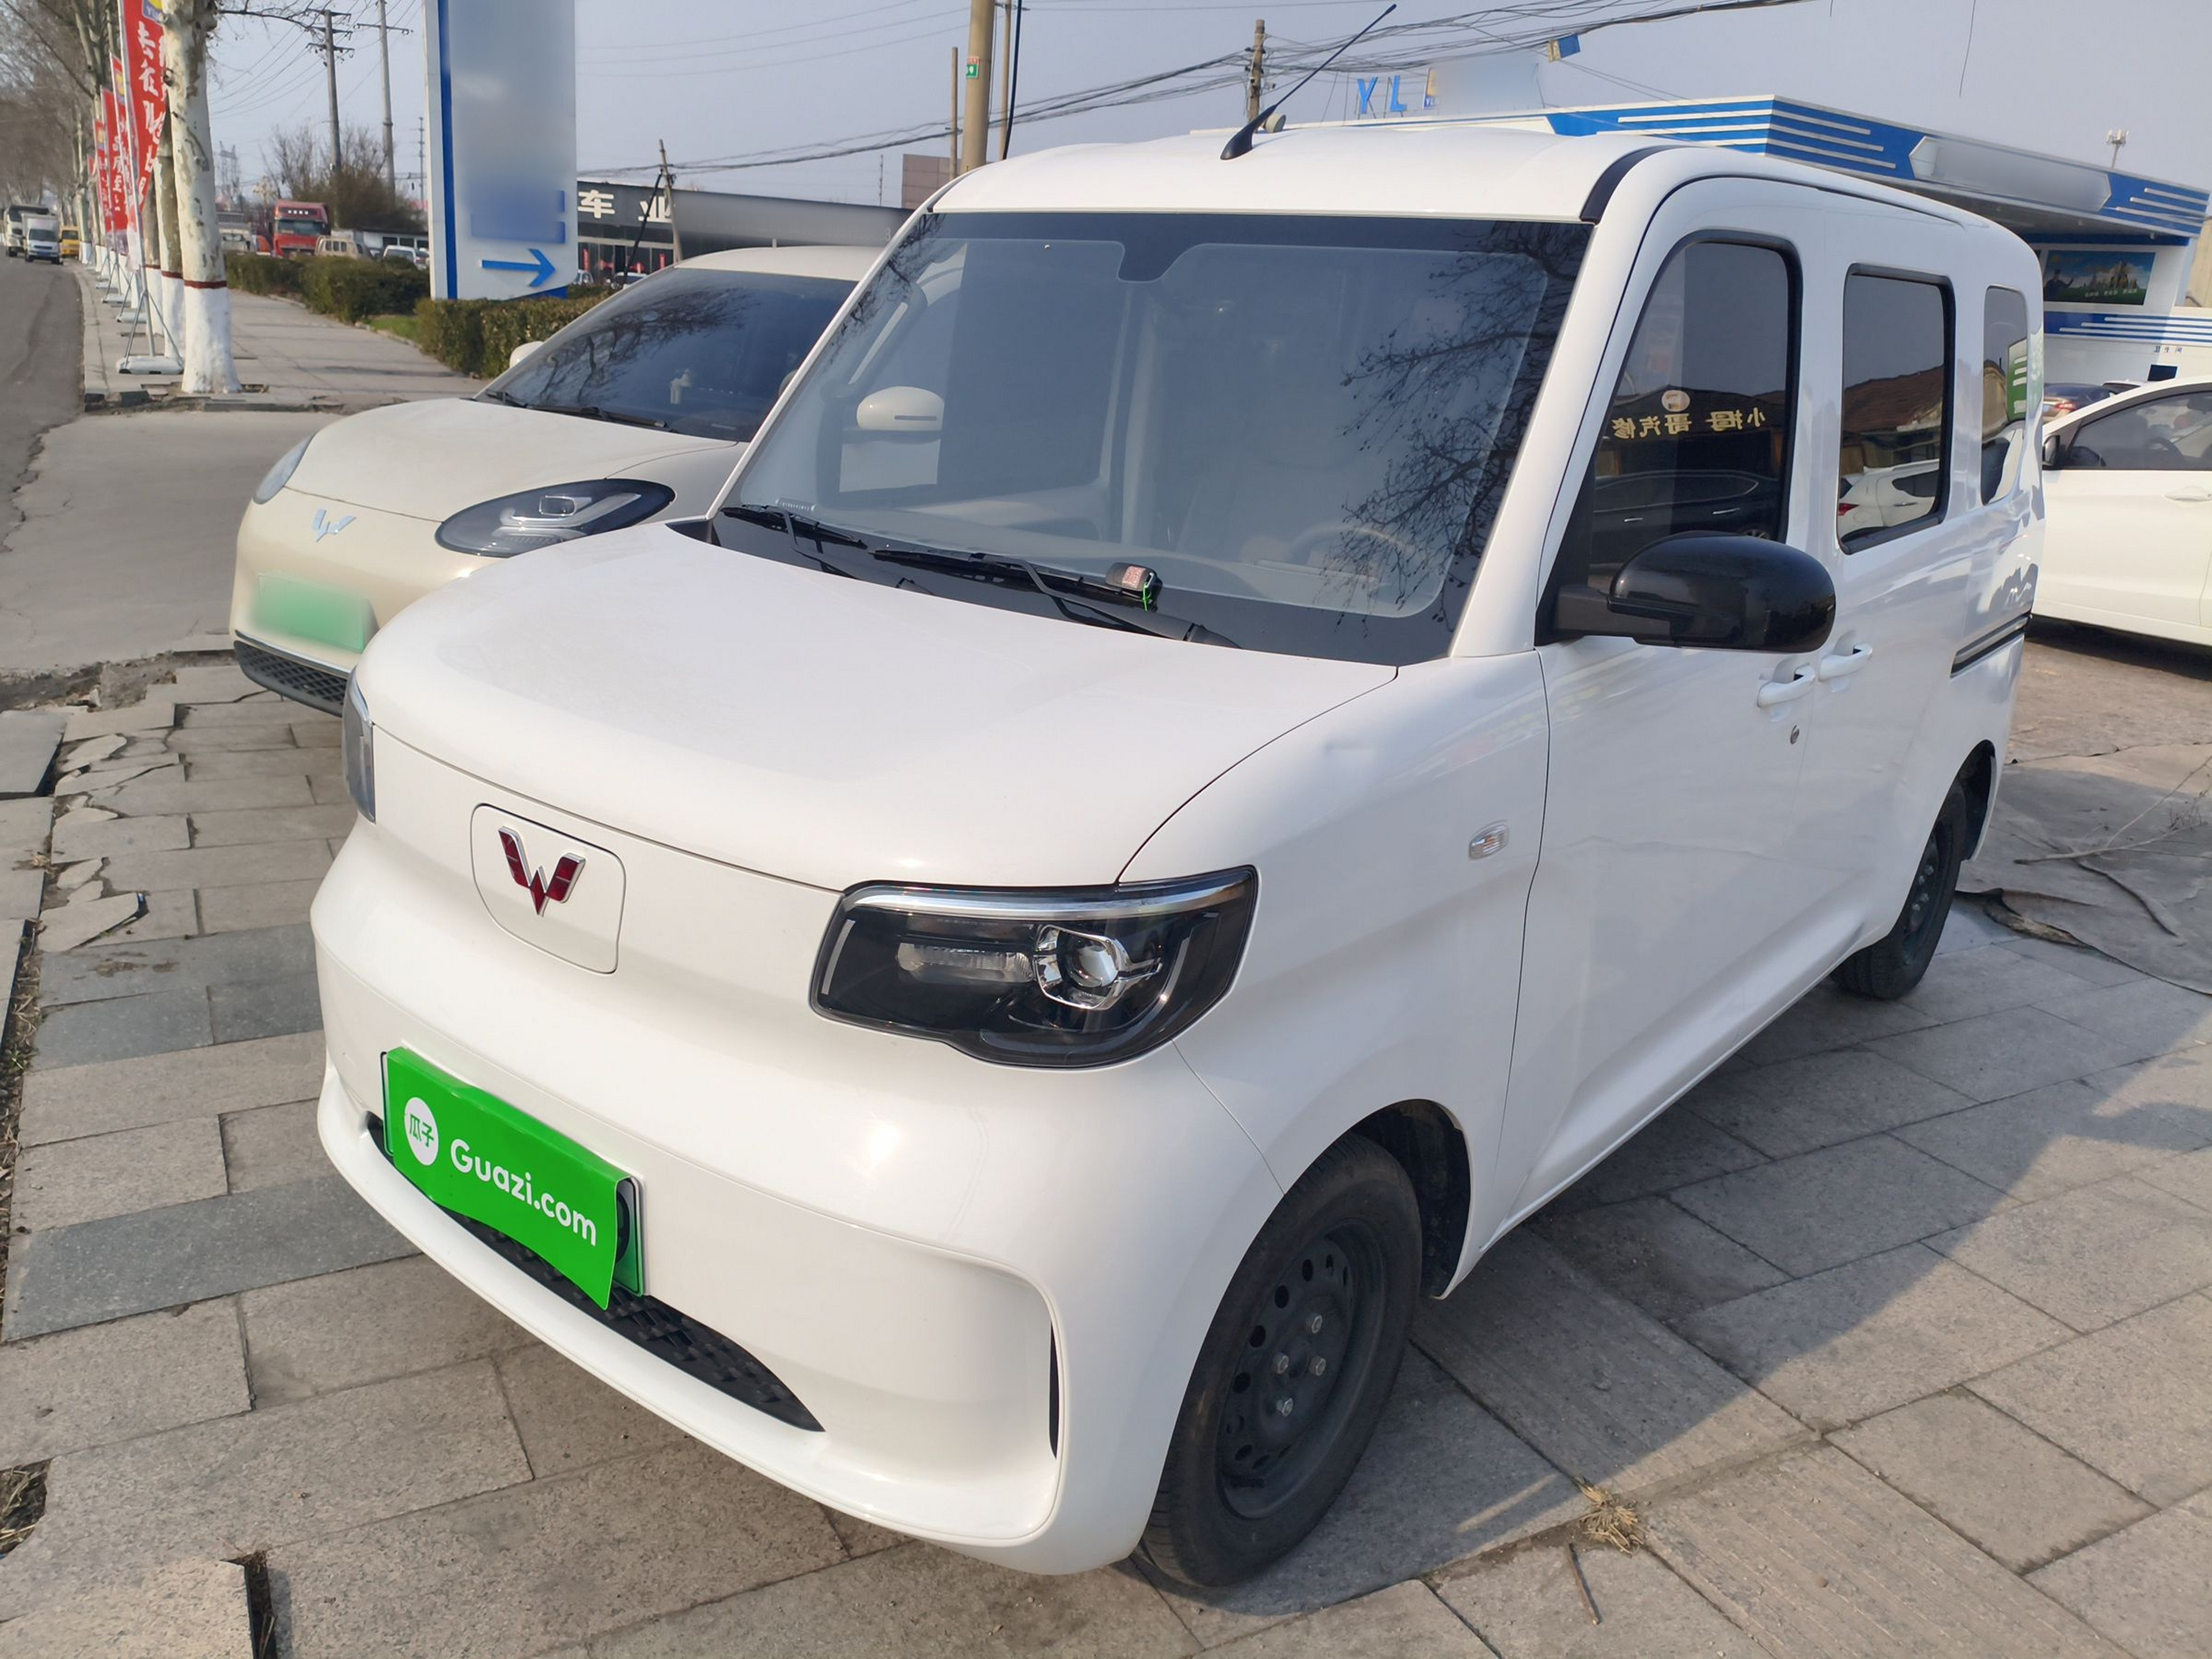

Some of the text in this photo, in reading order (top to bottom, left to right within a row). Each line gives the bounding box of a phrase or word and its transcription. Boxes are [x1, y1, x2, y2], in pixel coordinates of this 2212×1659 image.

[577, 190, 672, 223] 车业
[410, 1113, 434, 1148] 瓜子
[450, 1139, 597, 1248] Guazi.com
